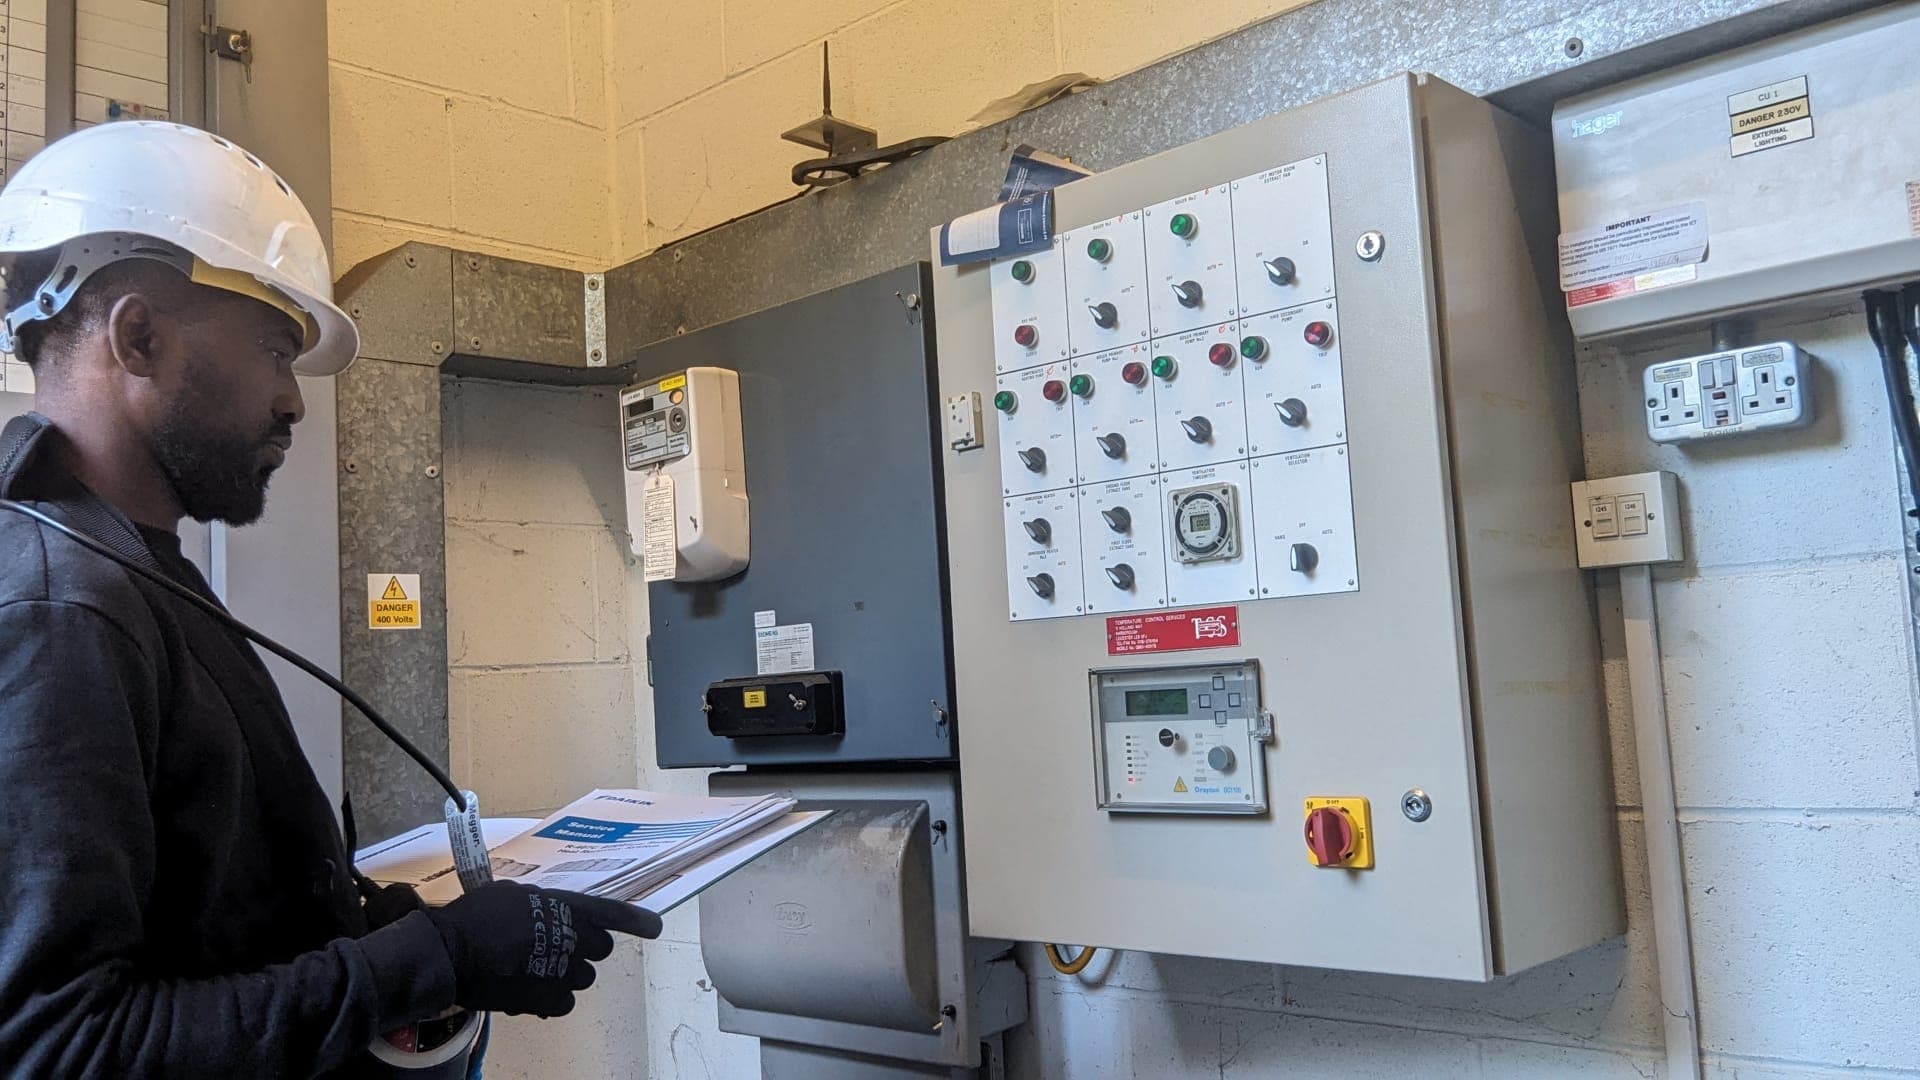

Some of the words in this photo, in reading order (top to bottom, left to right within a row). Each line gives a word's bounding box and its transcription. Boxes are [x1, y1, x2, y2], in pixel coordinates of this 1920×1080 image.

[1758, 91, 1770, 101] CU
[1739, 111, 1775, 128] DANGER
[1777, 104, 1802, 118] 230V
[1571, 110, 1623, 138] hager
[1752, 127, 1788, 140] EXTERNAL
[1754, 135, 1788, 148] LIGHTING
[1605, 216, 1651, 232] IMPORTANT
[376, 604, 413, 612] DANGER
[567, 821, 617, 832] Service
[554, 829, 605, 839] Manual
